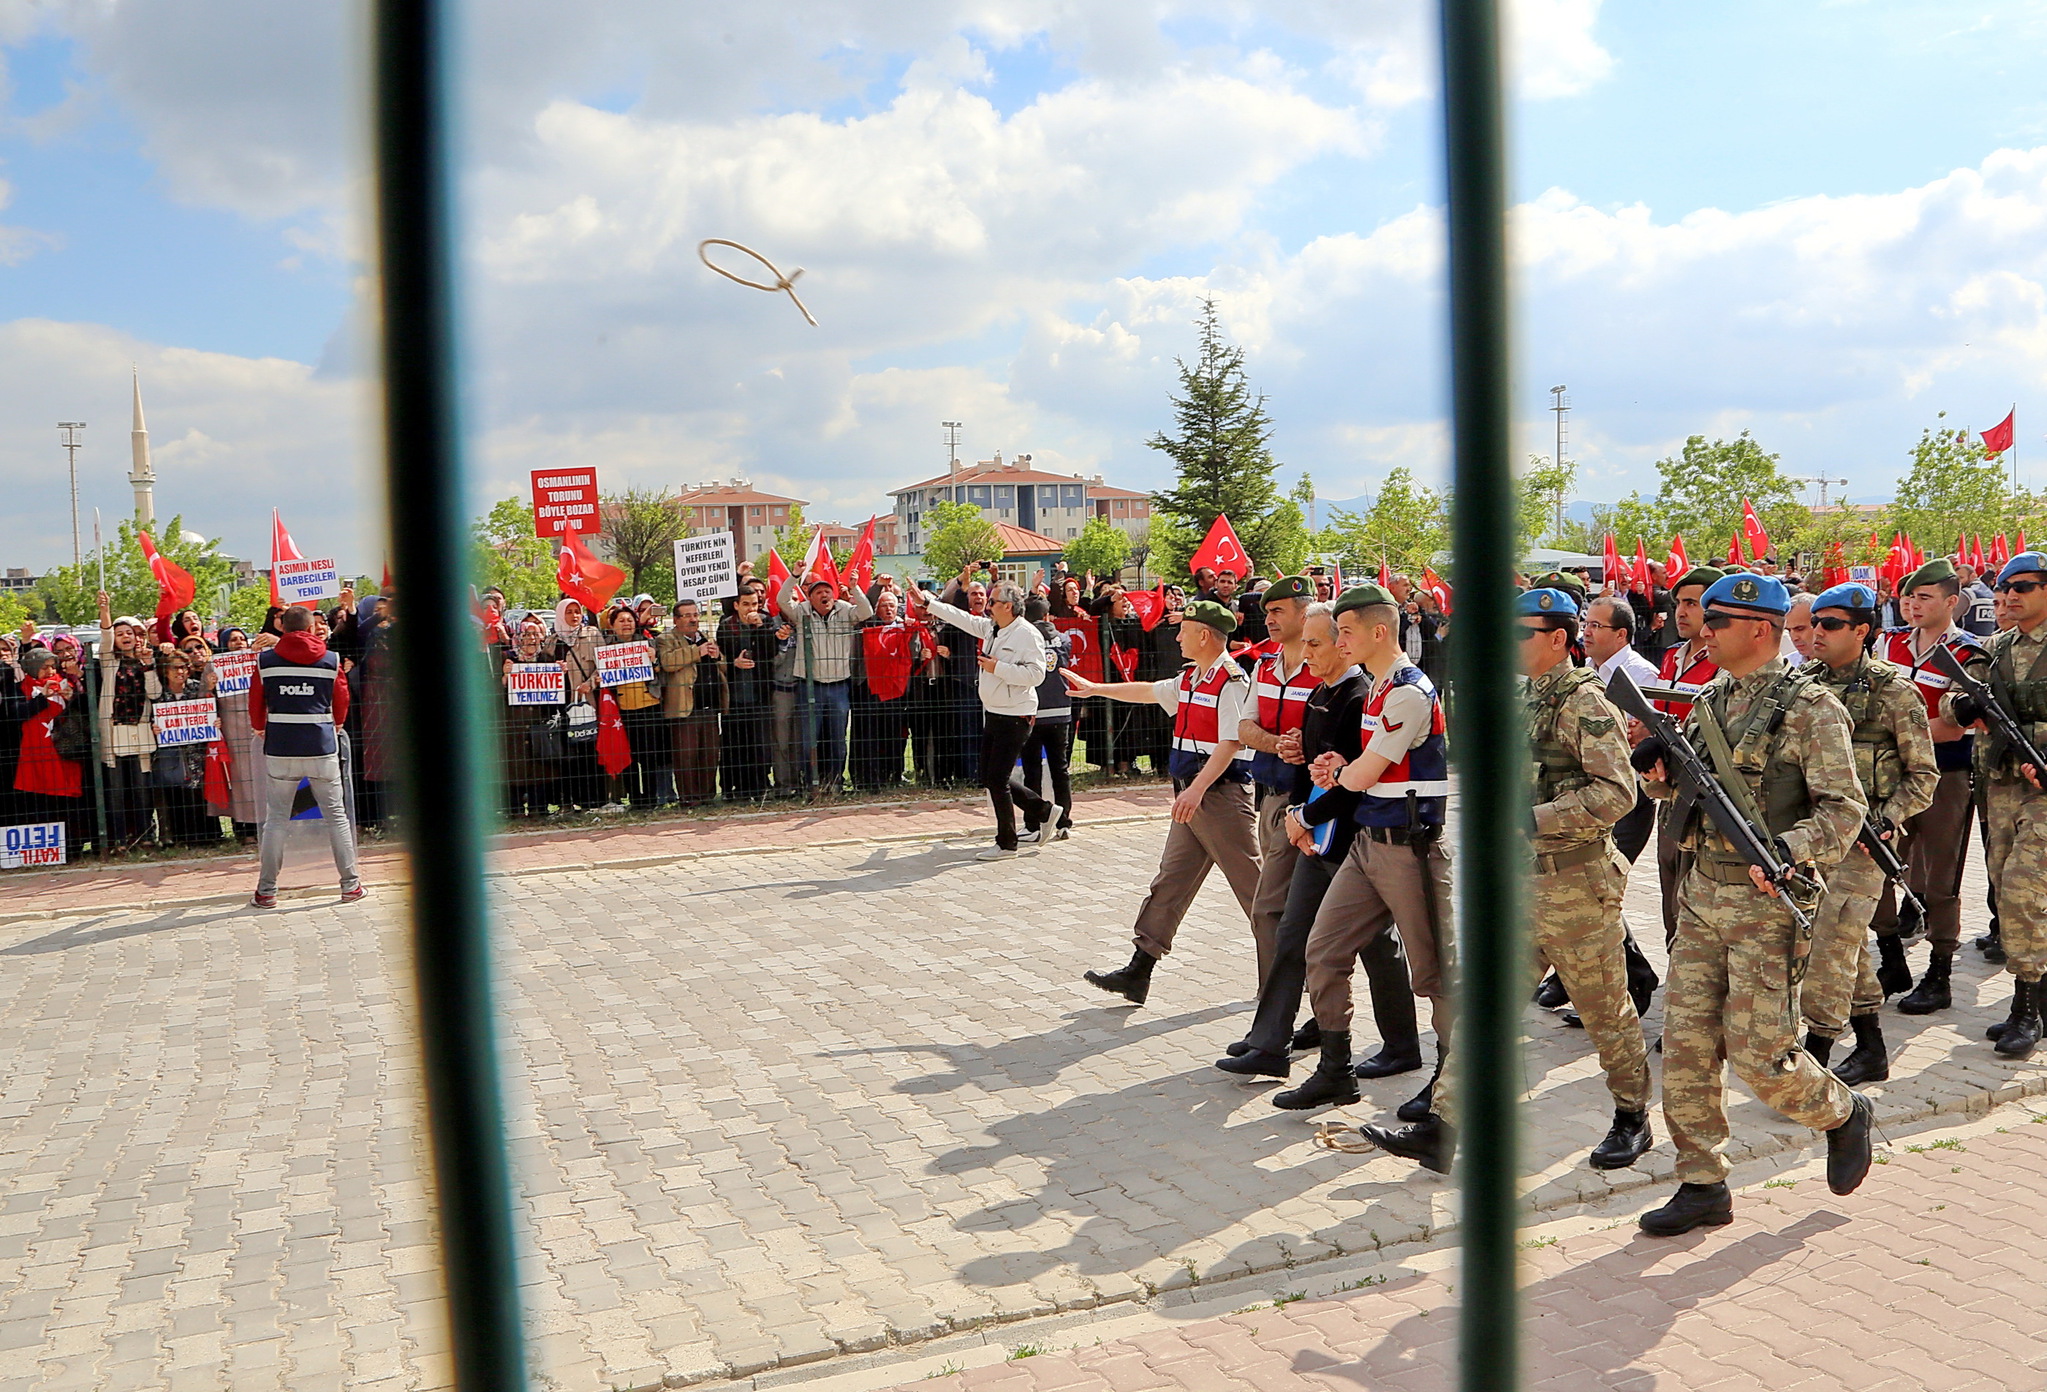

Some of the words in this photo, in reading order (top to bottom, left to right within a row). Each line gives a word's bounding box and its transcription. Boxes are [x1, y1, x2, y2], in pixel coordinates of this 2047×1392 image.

[547, 489, 583, 503] TORUNU
[538, 504, 566, 518] BÖYLE
[566, 503, 594, 516] BOZAR
[553, 518, 583, 532] OYNU
[310, 558, 335, 571] NESLİ
[685, 549, 724, 564] NEFERLERİ
[680, 564, 707, 577] OYUNU
[707, 559, 730, 572] YENDİ
[280, 570, 337, 587] DARBECİLERİ
[682, 576, 707, 588] HESAP
[708, 571, 730, 584] GÜNÜ
[296, 585, 324, 597] YENDİ
[696, 585, 718, 598] GELDİ
[510, 669, 563, 690] TÜRKİYE
[601, 665, 652, 684] KALMASIN
[279, 682, 315, 696] POLİS
[159, 725, 217, 745] KALMASIN
[6, 825, 59, 856] FETÖ
[20, 847, 60, 864] KATİL
